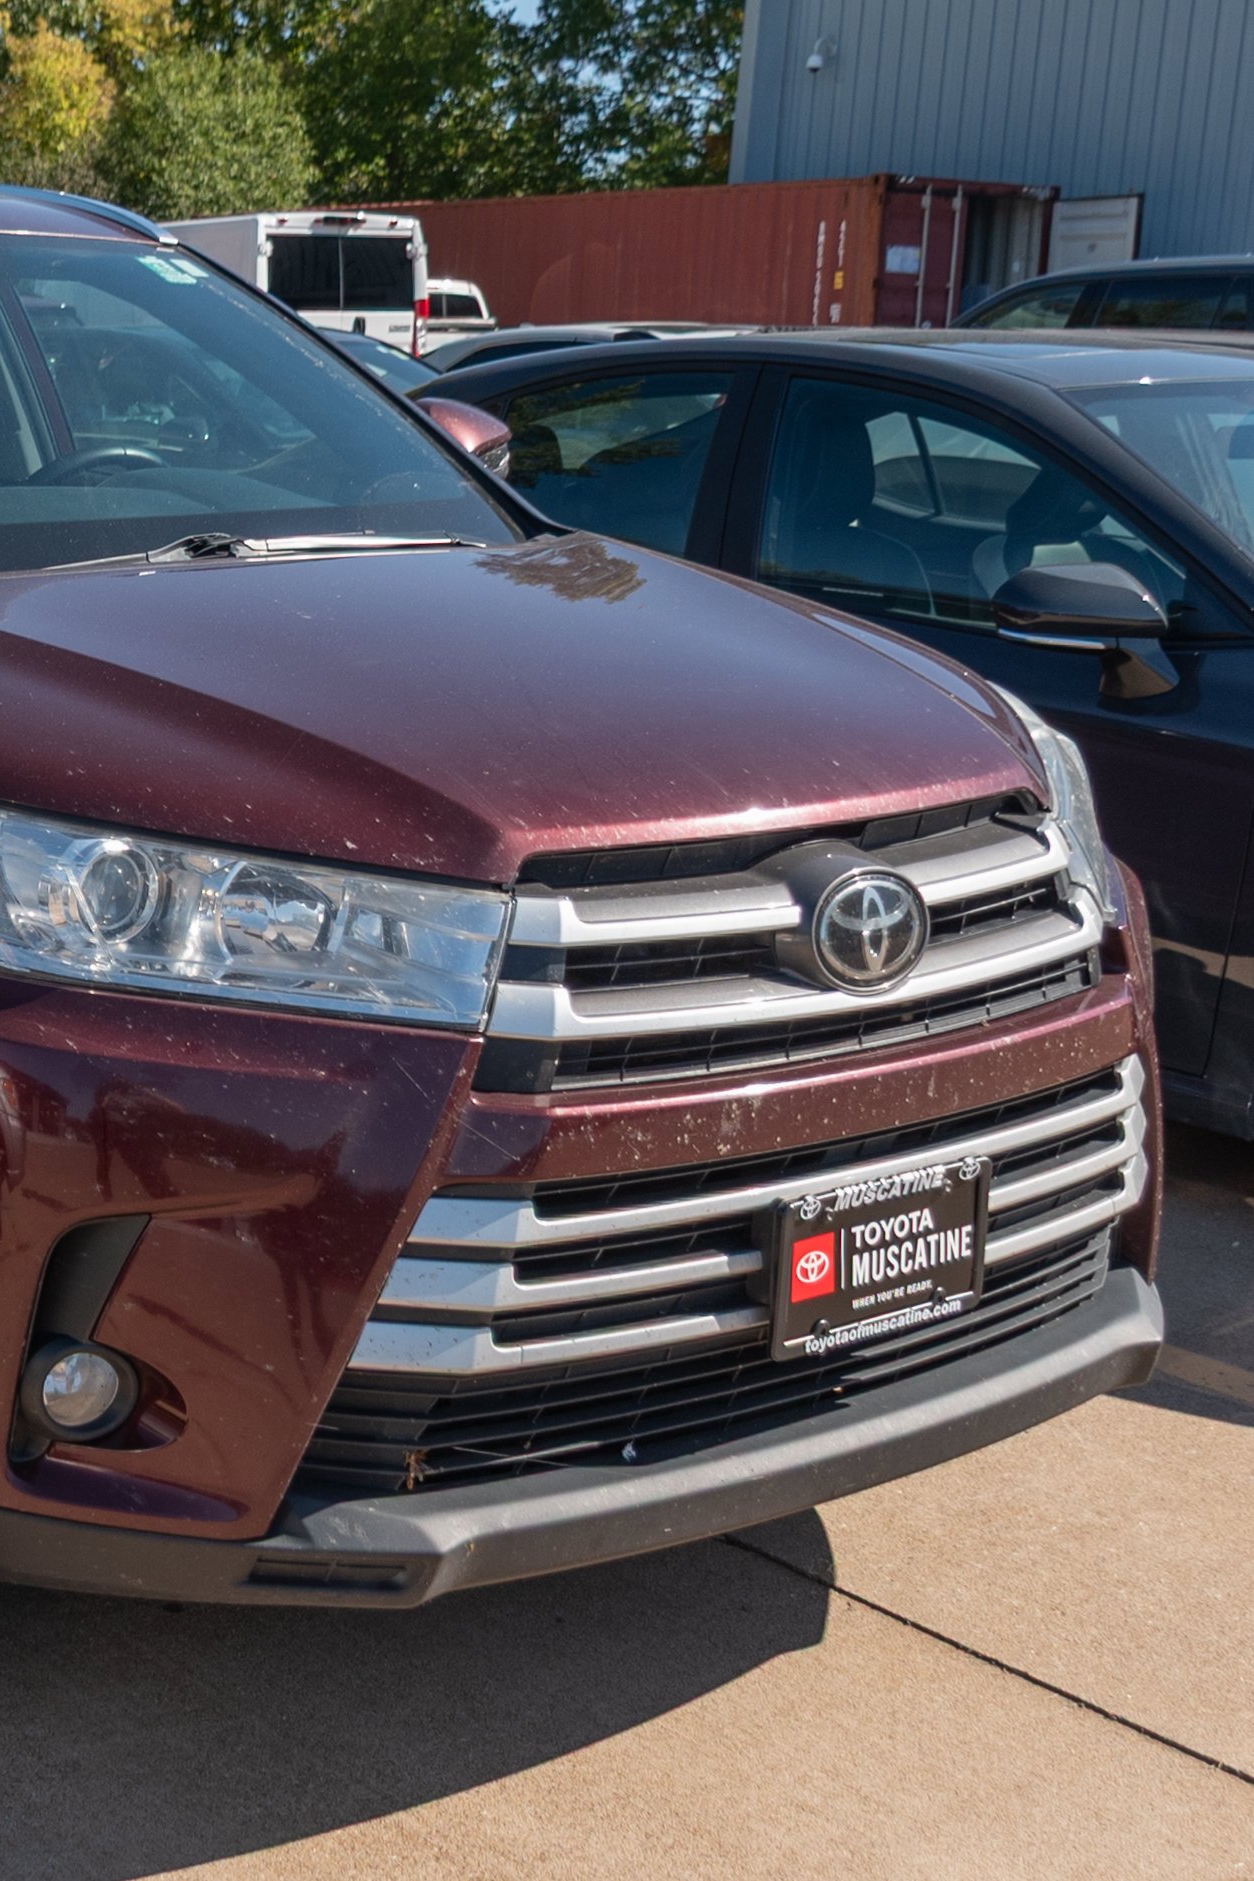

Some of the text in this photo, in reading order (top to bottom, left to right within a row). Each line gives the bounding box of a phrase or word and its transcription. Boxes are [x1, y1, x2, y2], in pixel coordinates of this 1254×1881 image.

[834, 1165, 946, 1211] MUSCATINE
[851, 1208, 934, 1248] TOYOTA
[852, 1225, 973, 1287] MUSCATINE
[852, 1297, 876, 1310] WHEN
[877, 1287, 905, 1303] YOU'RE
[805, 1300, 962, 1353] toyotaofmuscatine.com
